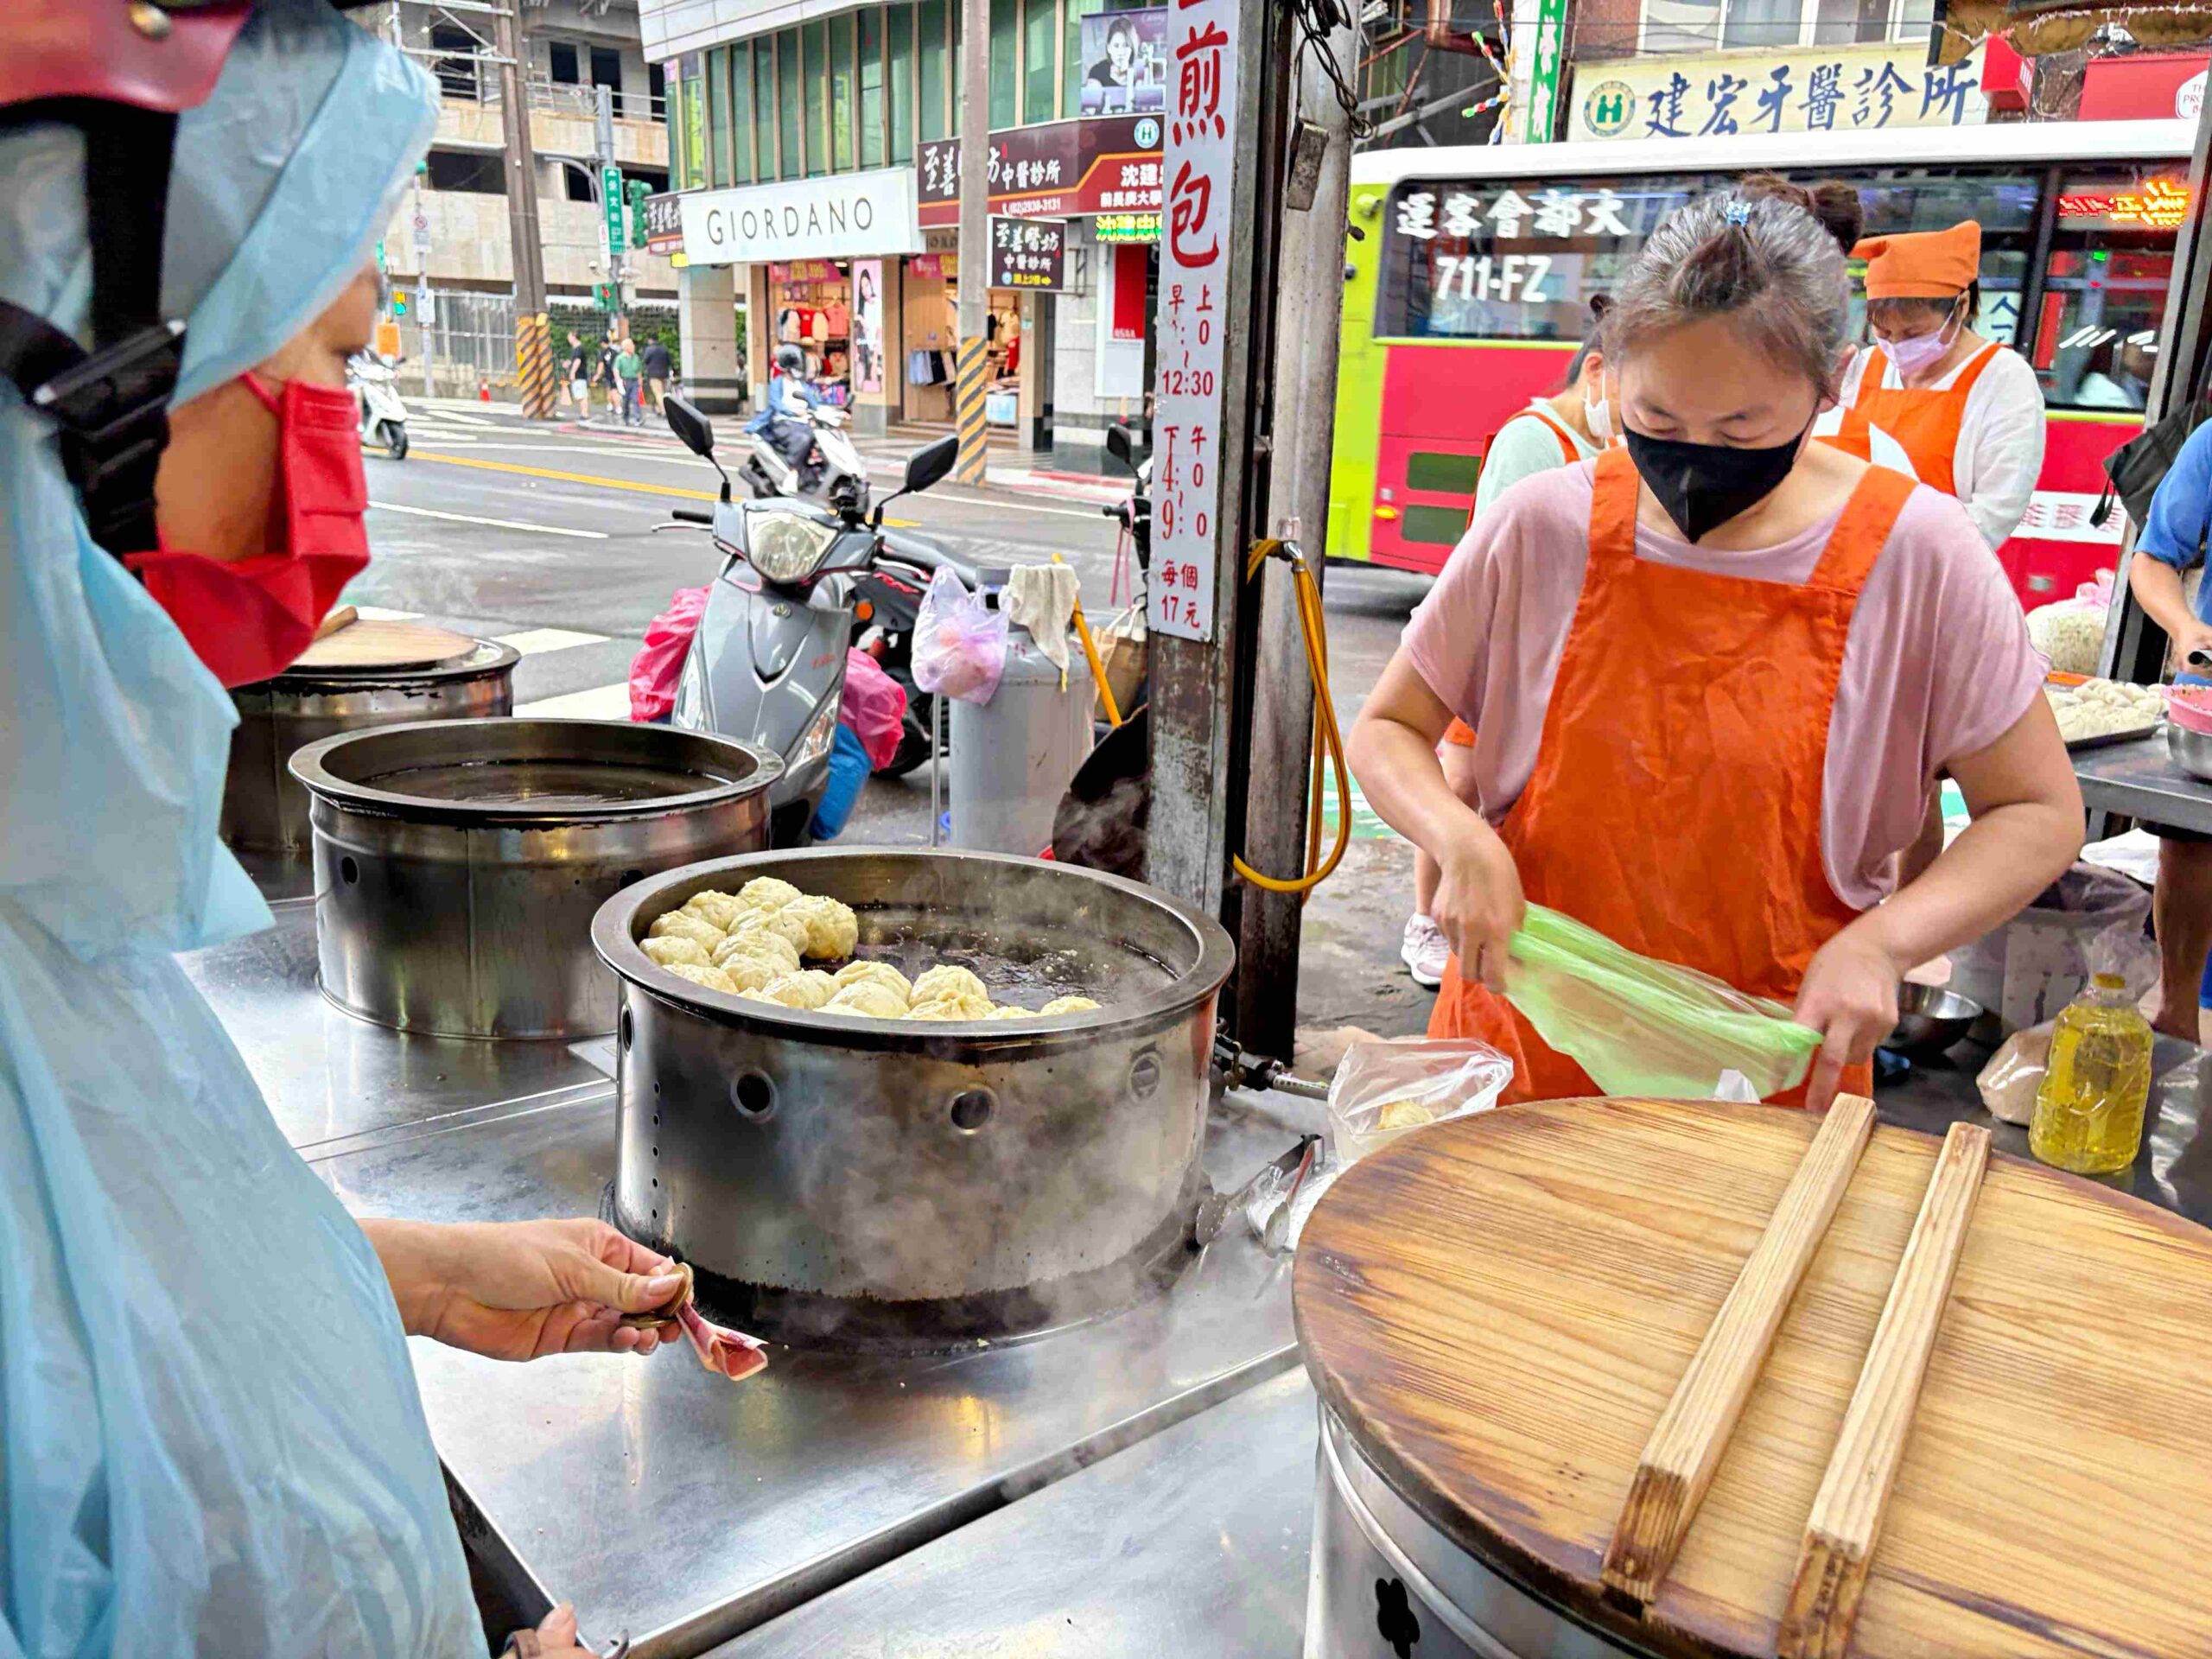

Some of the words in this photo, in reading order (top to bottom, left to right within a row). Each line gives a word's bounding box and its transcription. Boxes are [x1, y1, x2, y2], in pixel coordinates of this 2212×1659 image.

[1643, 59, 1979, 138] 建宏牙醫診所
[1121, 163, 1163, 187] 沈建
[707, 197, 873, 245] GIORDANO
[1003, 252, 1052, 272] 中醫診所
[1436, 255, 1553, 302] 711-FZ
[1168, 283, 1212, 315] 早上
[1162, 368, 1214, 397] 12:30
[1163, 425, 1207, 455] 下午
[1160, 558, 1198, 591] 每個
